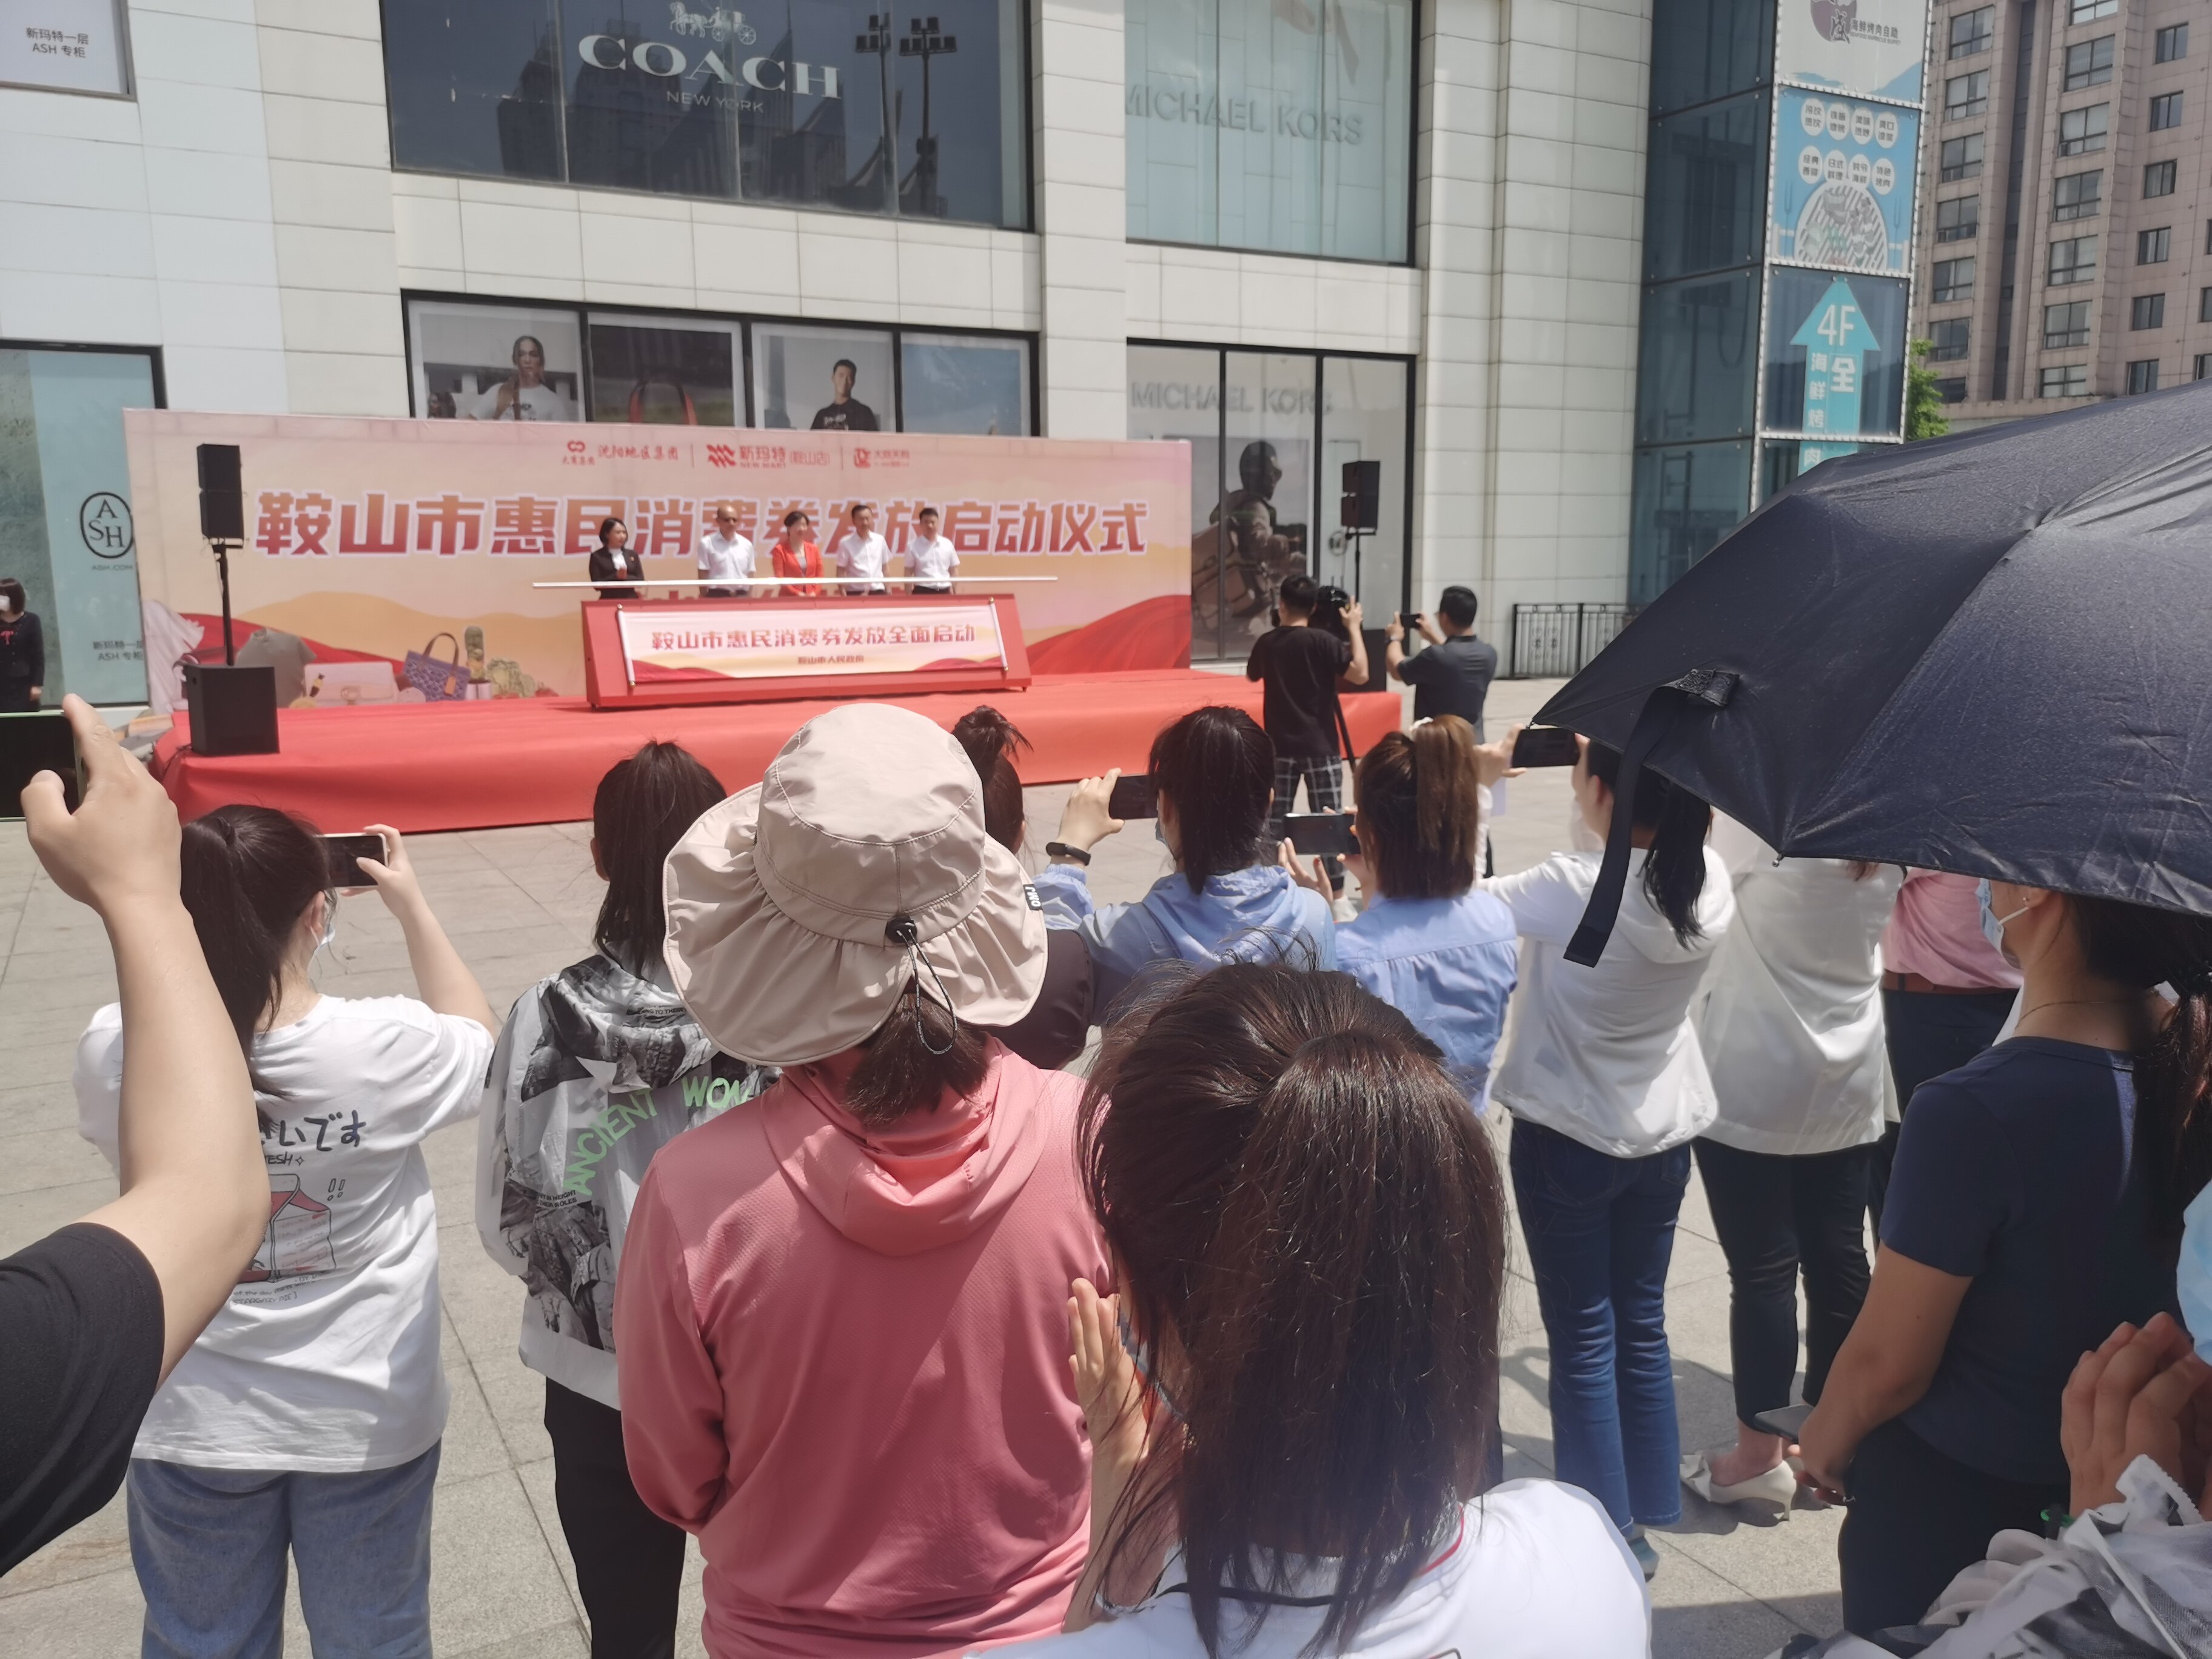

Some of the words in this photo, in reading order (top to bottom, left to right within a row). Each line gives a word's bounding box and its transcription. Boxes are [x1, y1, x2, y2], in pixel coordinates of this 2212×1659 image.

[26, 27, 89, 45] 新玛特一层
[32, 43, 57, 54] ASH
[61, 45, 86, 58] 专柜
[578, 35, 842, 99] COACH
[668, 91, 711, 107] NEW
[716, 97, 764, 113] YORK
[1278, 104, 1363, 146] KORS
[1828, 159, 1843, 169] 日式
[1817, 304, 1856, 346] 4F
[1131, 382, 1253, 413] MICHAEL
[739, 445, 786, 462] 新玛特
[651, 623, 976, 651] 鞍山市惠民消费券发放全面启动
[98, 652, 119, 661] ASH
[798, 655, 865, 665] 鞍山市人民政府
[563, 1088, 657, 1195] ANCIENT
[265, 1151, 293, 1166] ESH
